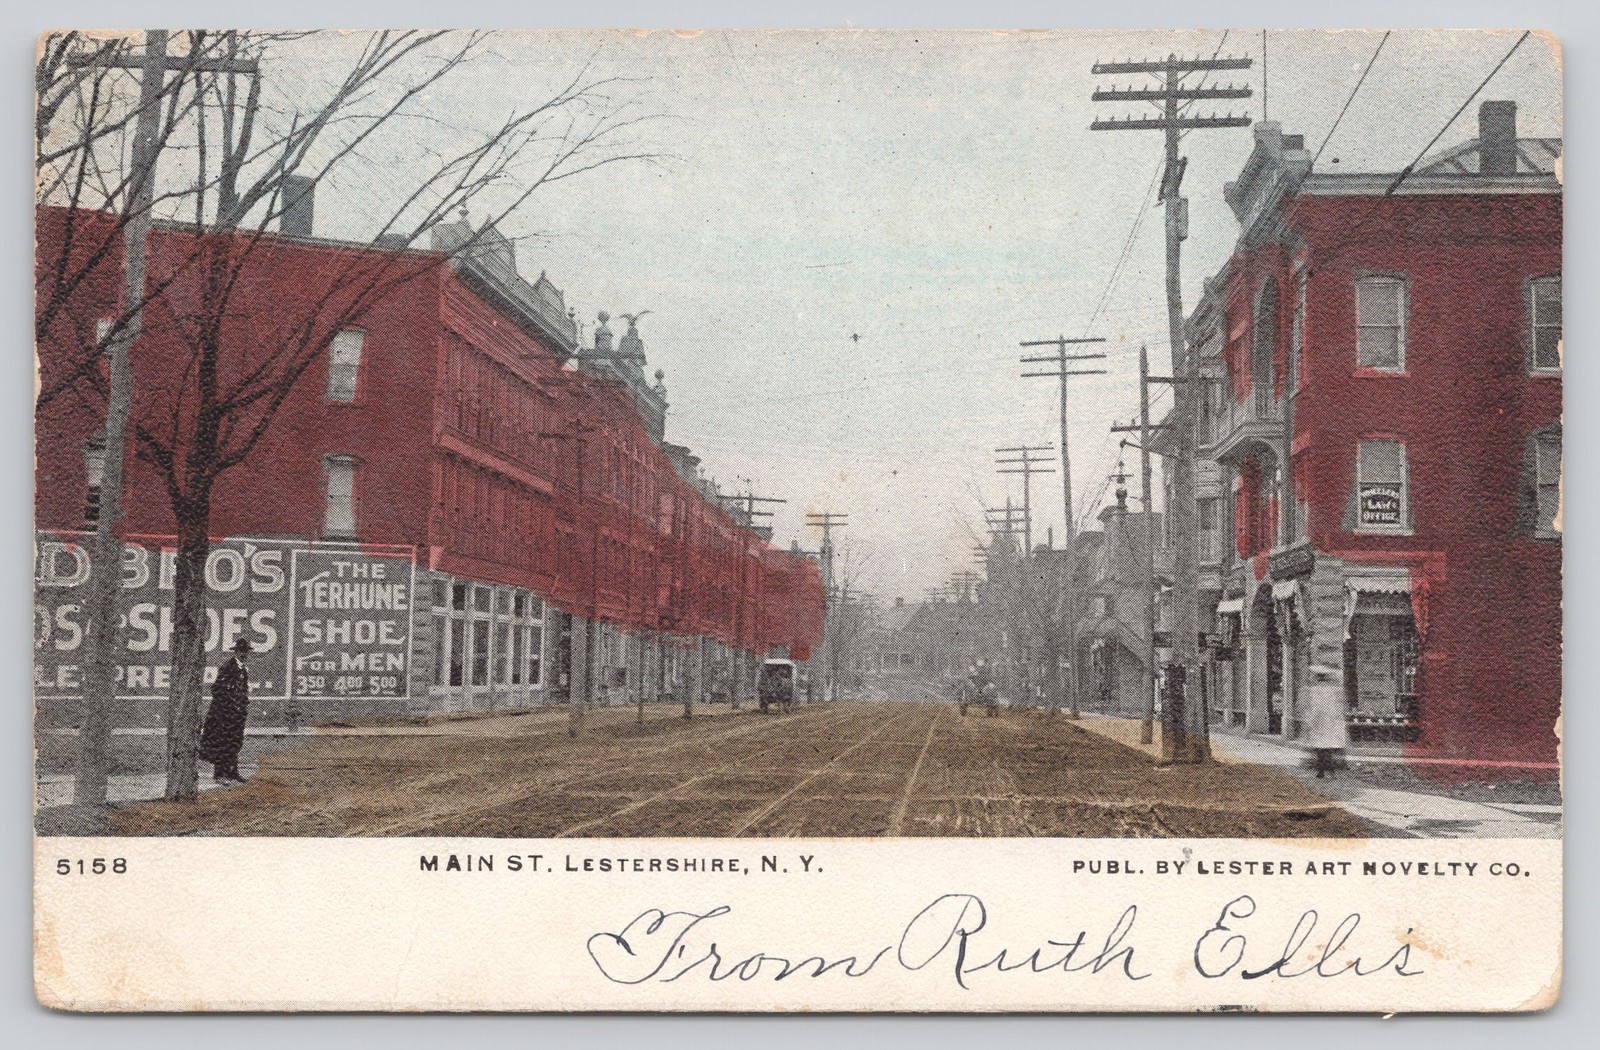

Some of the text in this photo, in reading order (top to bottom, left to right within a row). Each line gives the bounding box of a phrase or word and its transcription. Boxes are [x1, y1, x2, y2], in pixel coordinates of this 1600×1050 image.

[331, 560, 386, 580] THE
[299, 571, 409, 610] TERHUNE
[302, 619, 406, 645] SHOE
[341, 652, 404, 672] MEN
[587, 894, 1424, 990] From Ruth Ellis
